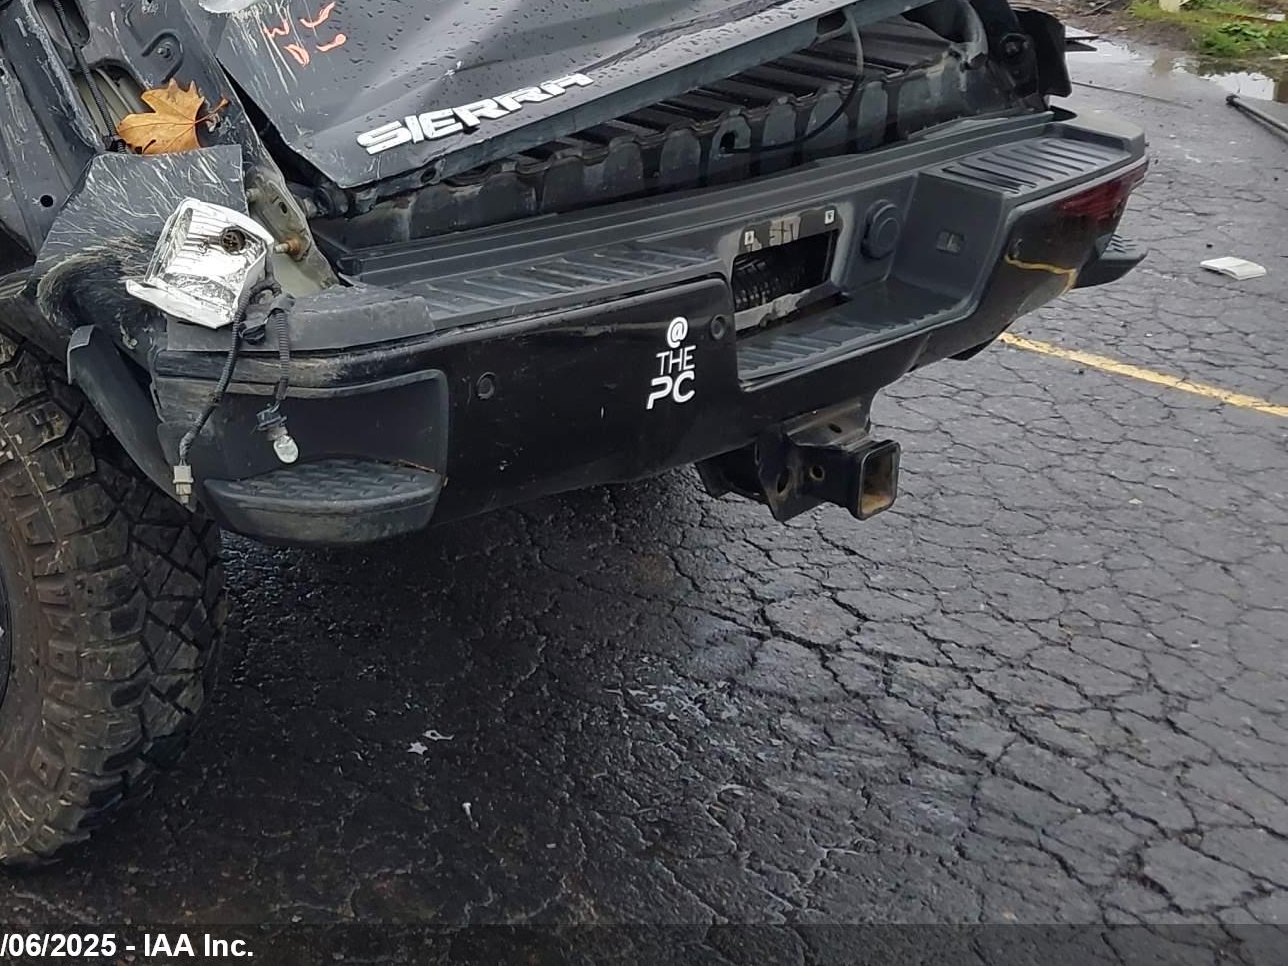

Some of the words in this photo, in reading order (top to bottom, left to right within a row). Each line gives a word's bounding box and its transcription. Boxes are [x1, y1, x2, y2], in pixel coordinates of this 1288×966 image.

[356, 73, 594, 156] SIERRA
[667, 316, 689, 349] @
[655, 344, 697, 376] THE
[646, 370, 696, 410] PC
